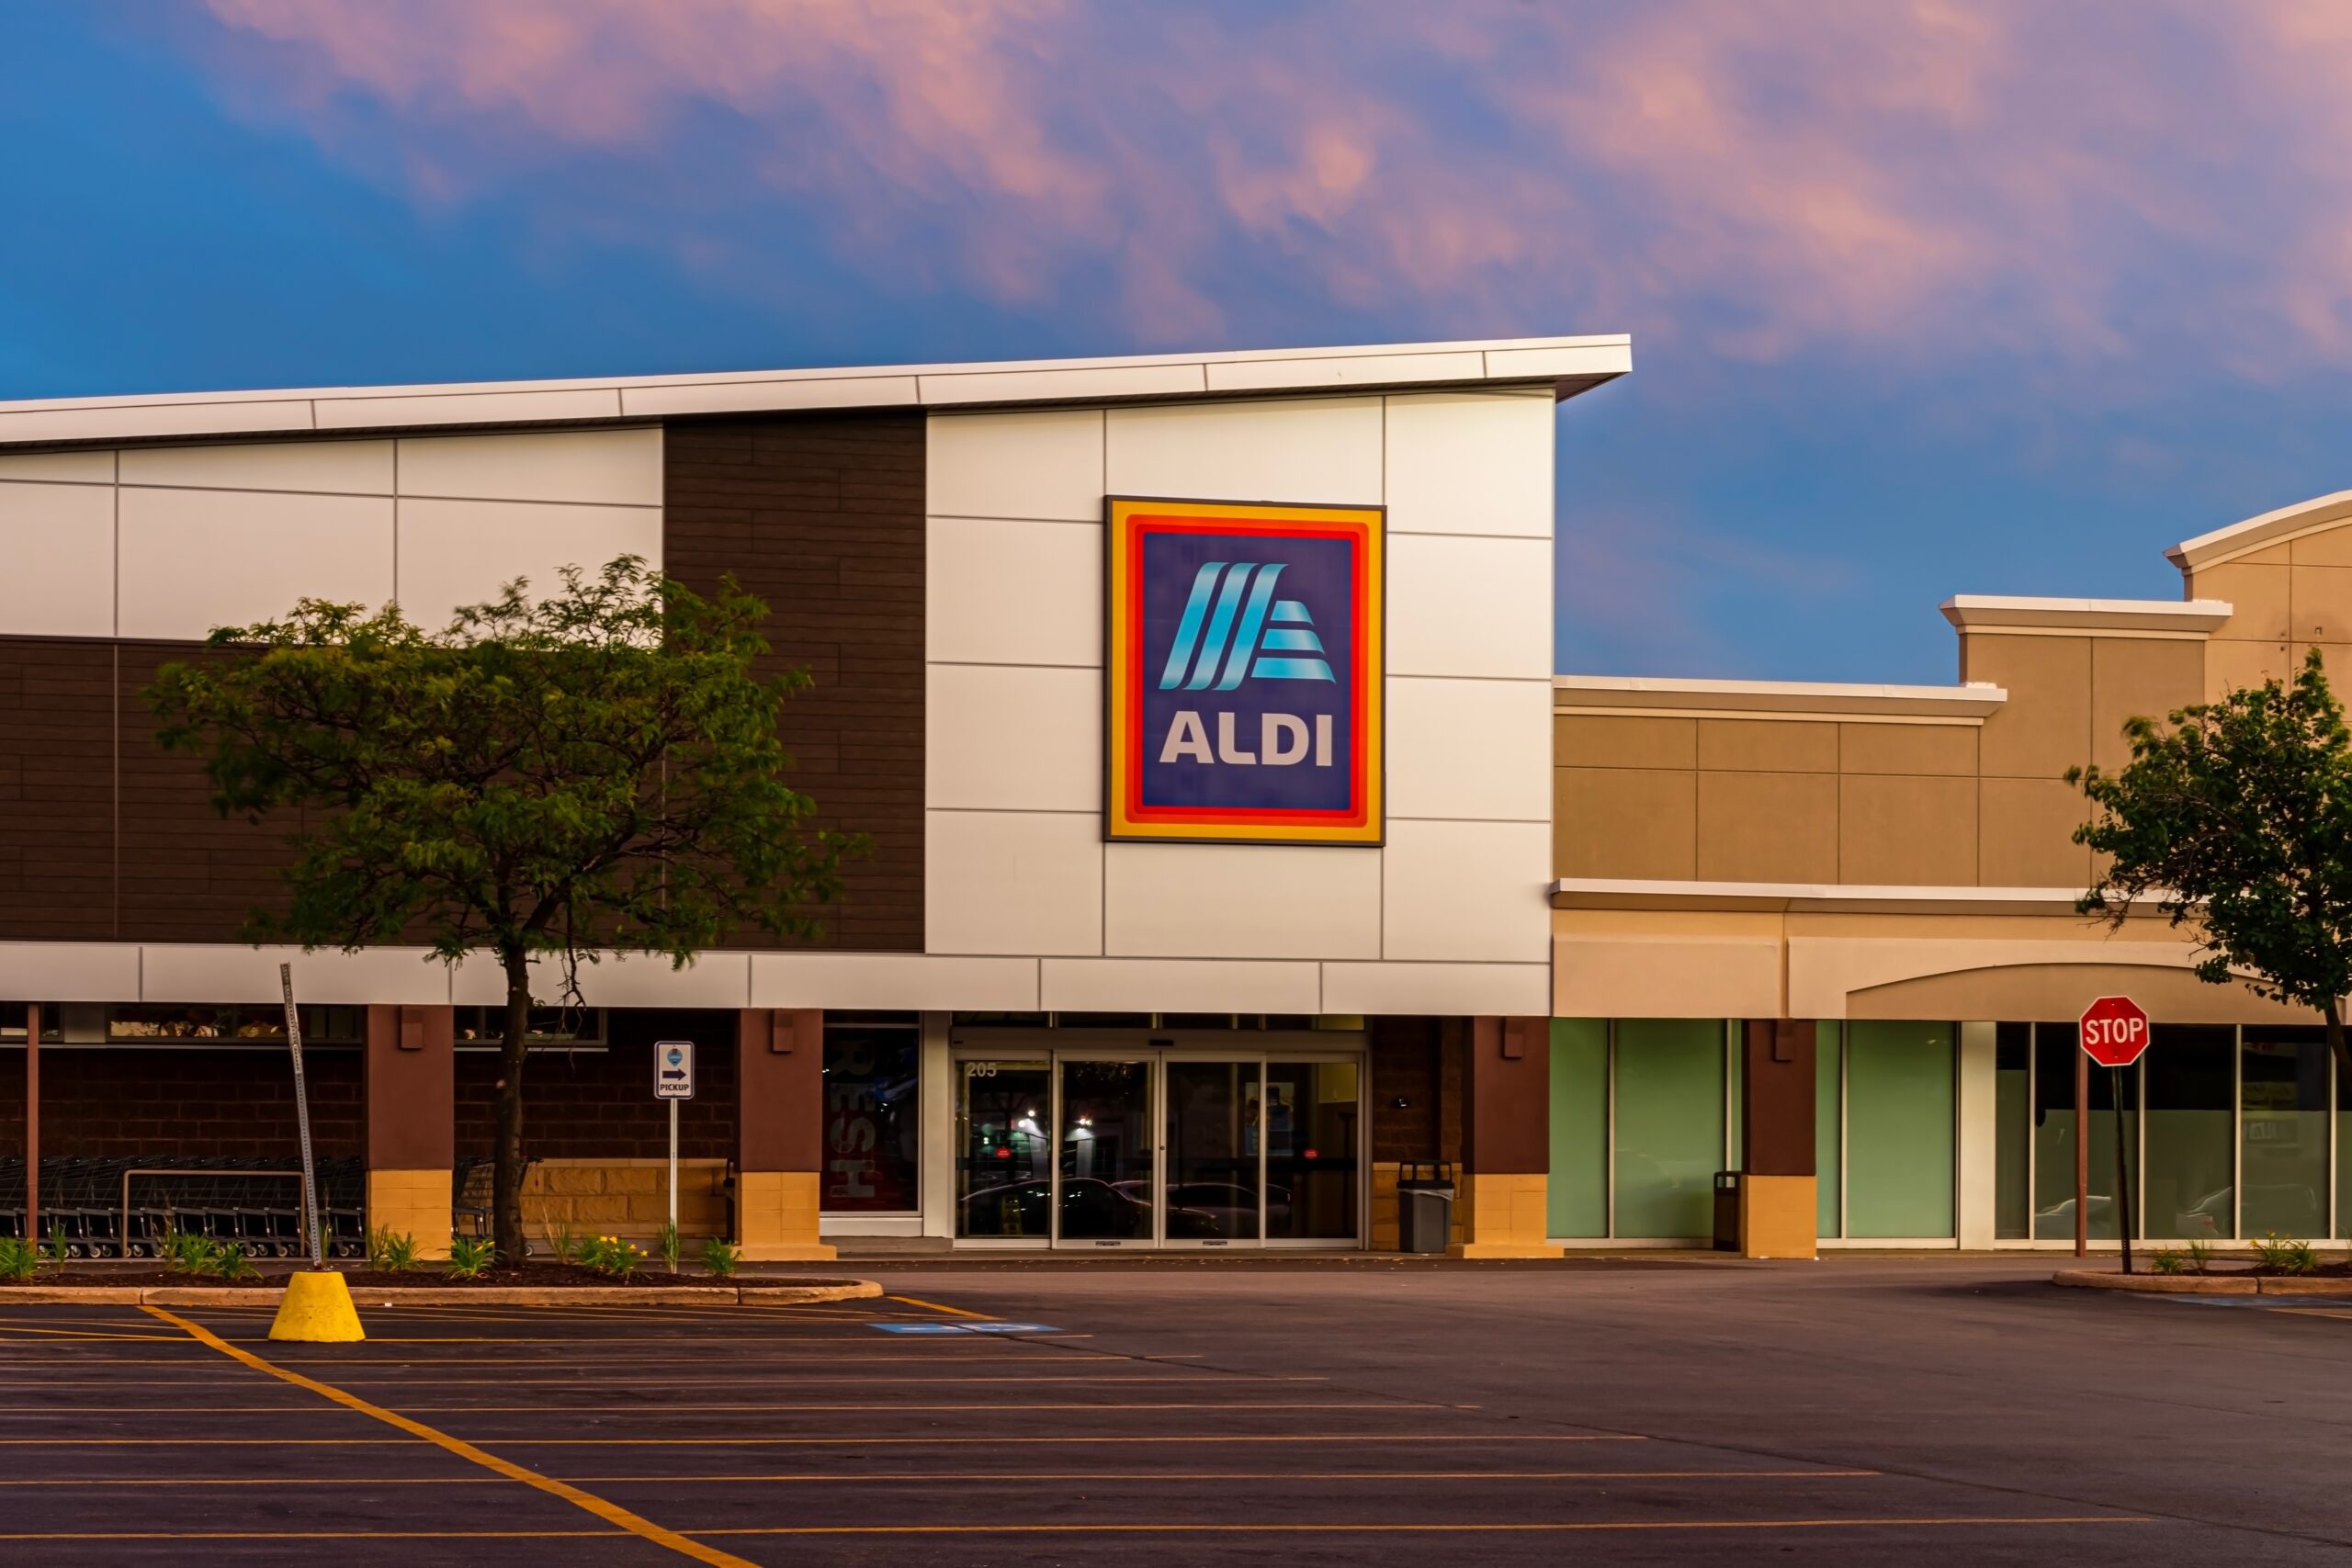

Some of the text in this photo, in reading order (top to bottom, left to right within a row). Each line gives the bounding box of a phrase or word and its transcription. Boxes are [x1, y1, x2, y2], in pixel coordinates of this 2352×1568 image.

[1159, 710, 1333, 767] ALDI
[2085, 1017, 2144, 1045] STOP
[967, 1062, 997, 1077] 205
